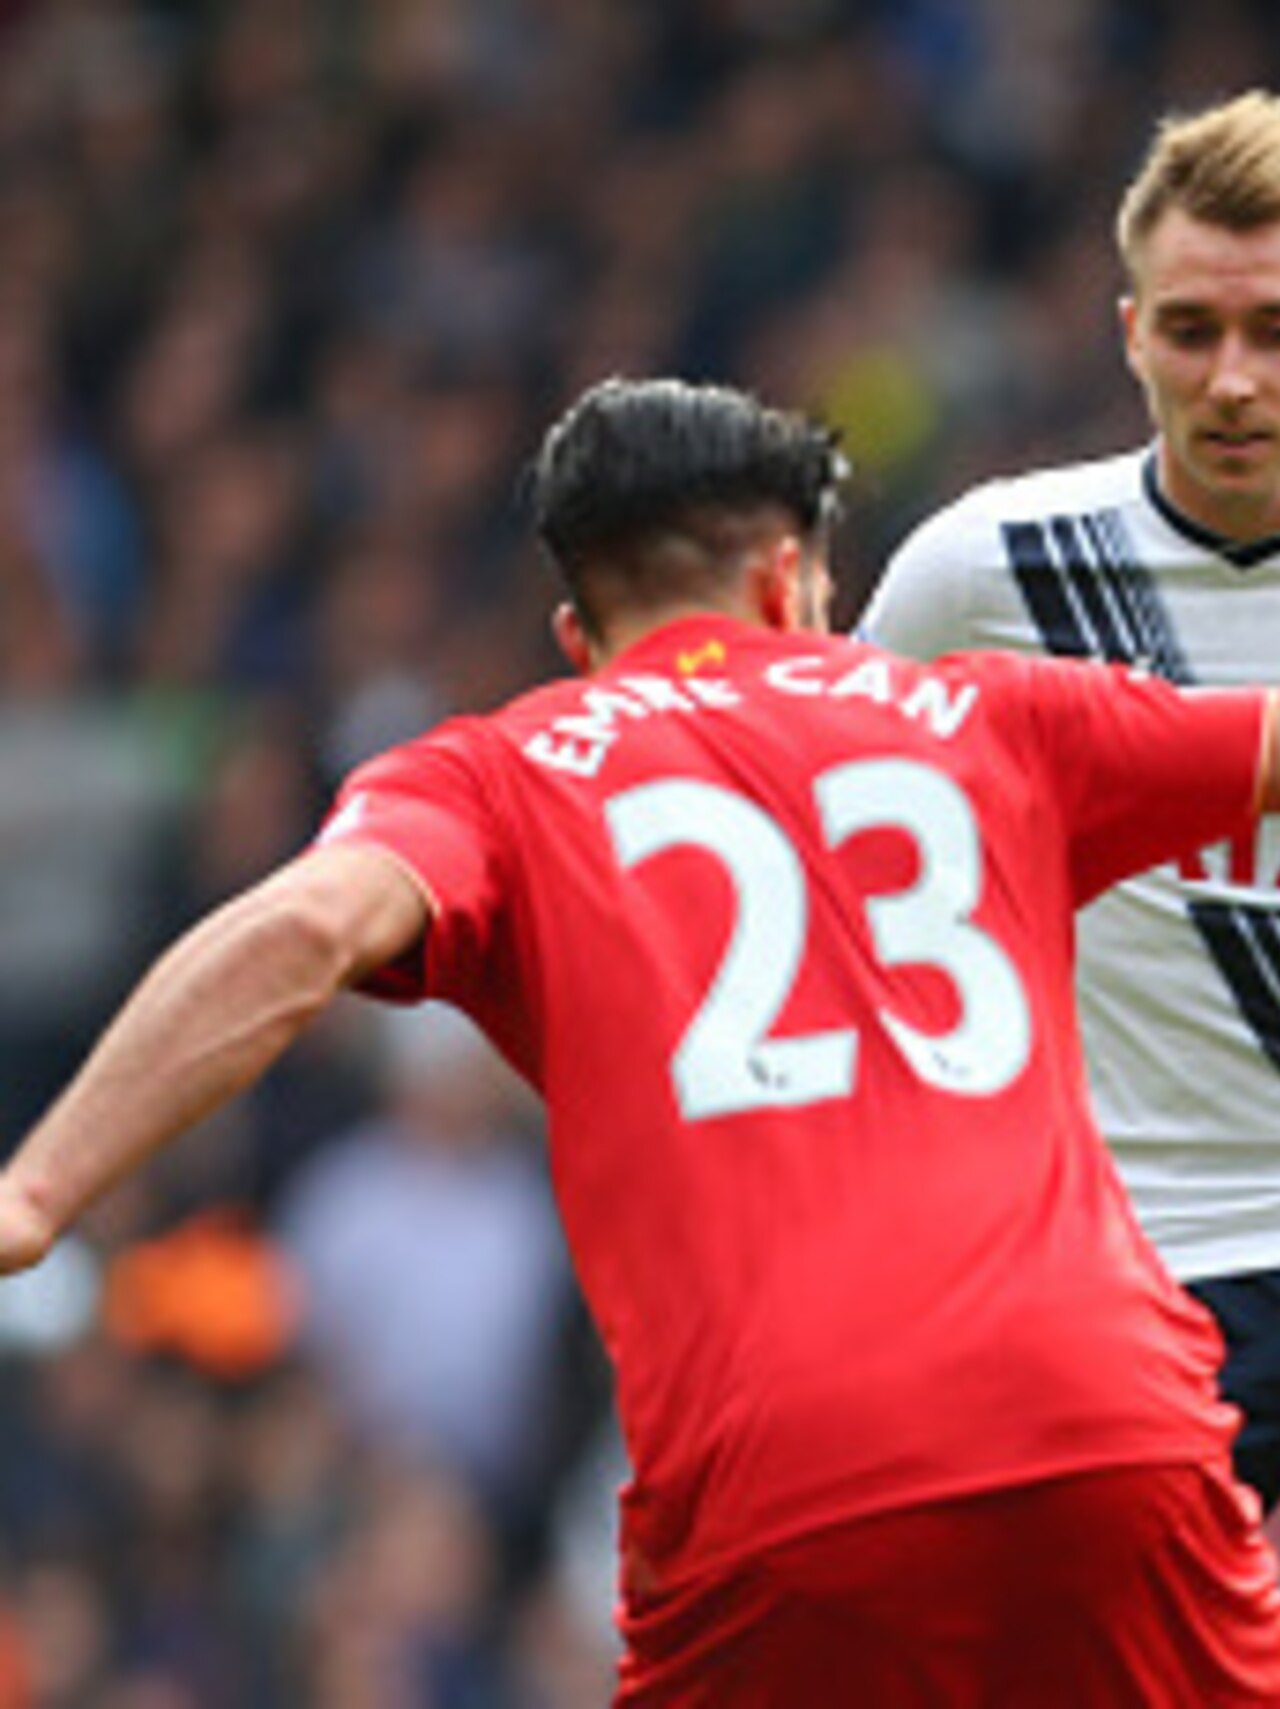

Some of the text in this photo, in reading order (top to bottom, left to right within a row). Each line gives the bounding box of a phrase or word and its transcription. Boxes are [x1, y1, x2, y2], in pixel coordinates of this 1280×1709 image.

[522, 656, 979, 778] EMRE CAN
[603, 756, 1031, 1122] 23
